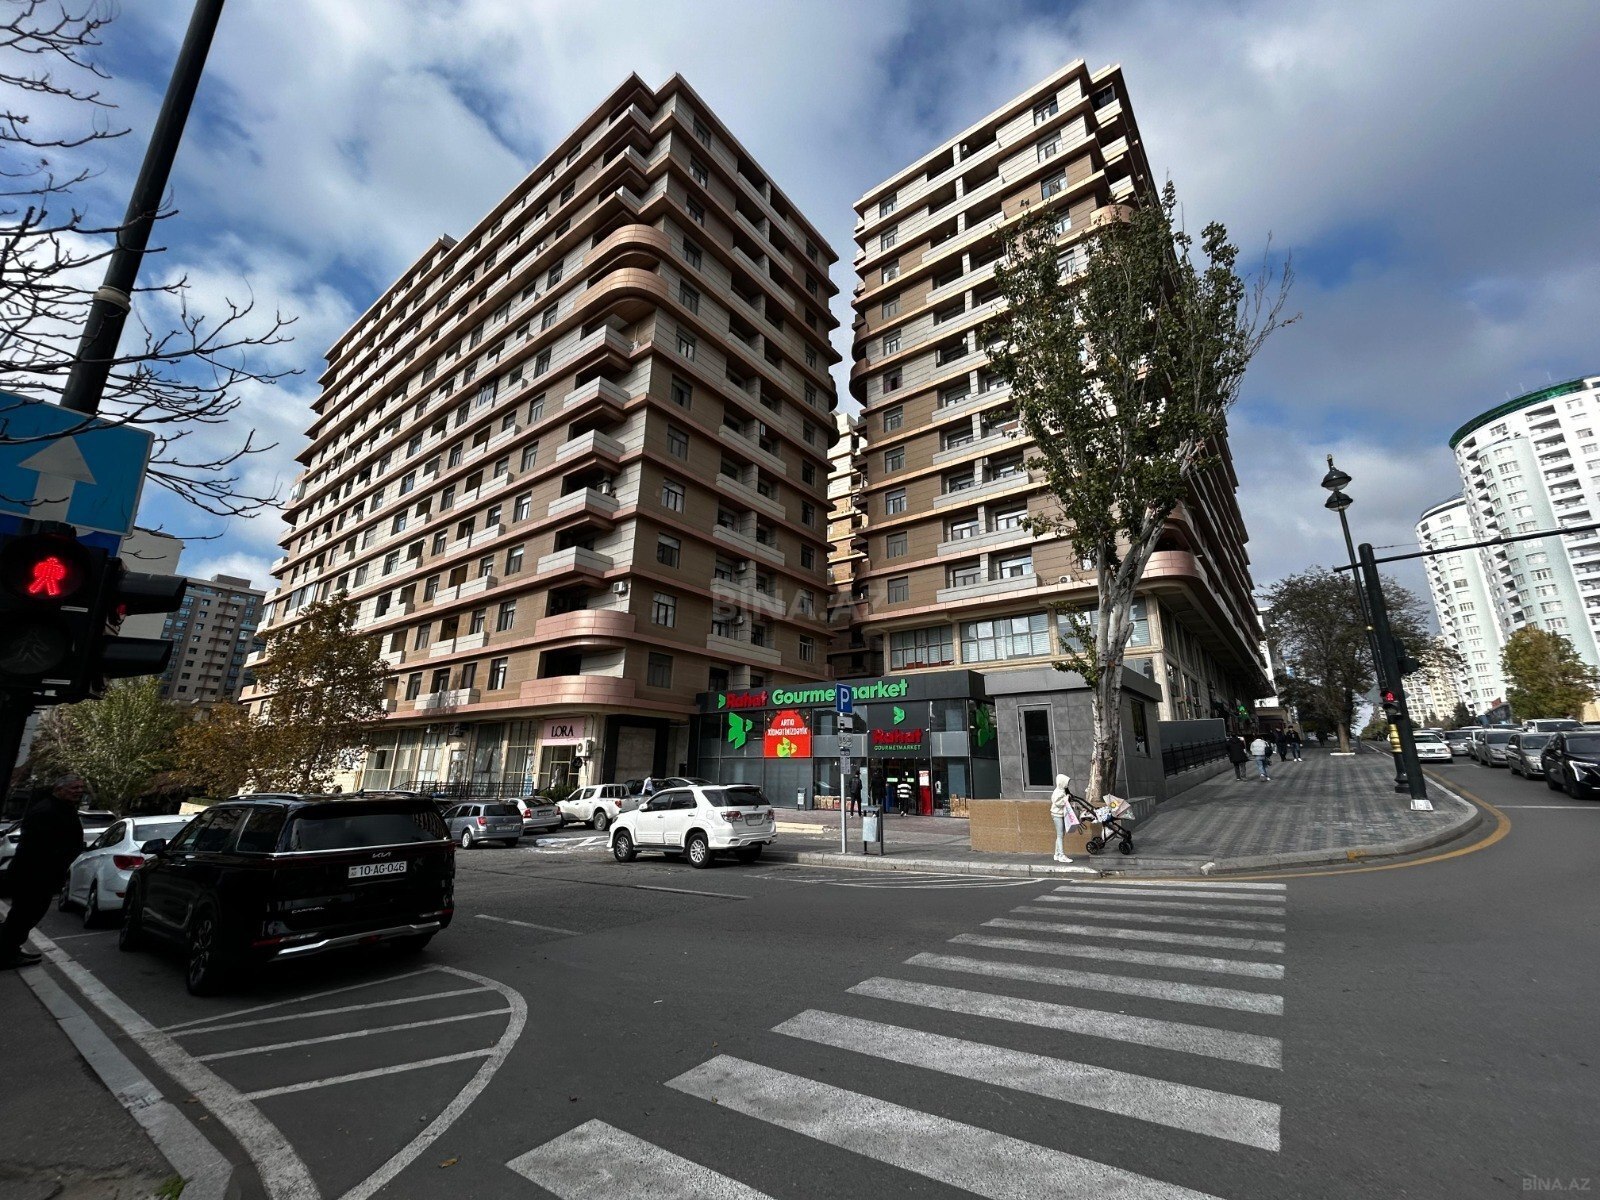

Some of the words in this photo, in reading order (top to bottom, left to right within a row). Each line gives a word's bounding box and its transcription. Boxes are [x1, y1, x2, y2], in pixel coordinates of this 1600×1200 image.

[726, 690, 769, 709] Rahat
[840, 687, 850, 710] P
[551, 725, 574, 738] LORA
[872, 728, 922, 744] Rahat
[359, 862, 405, 876] 10-AG-046
